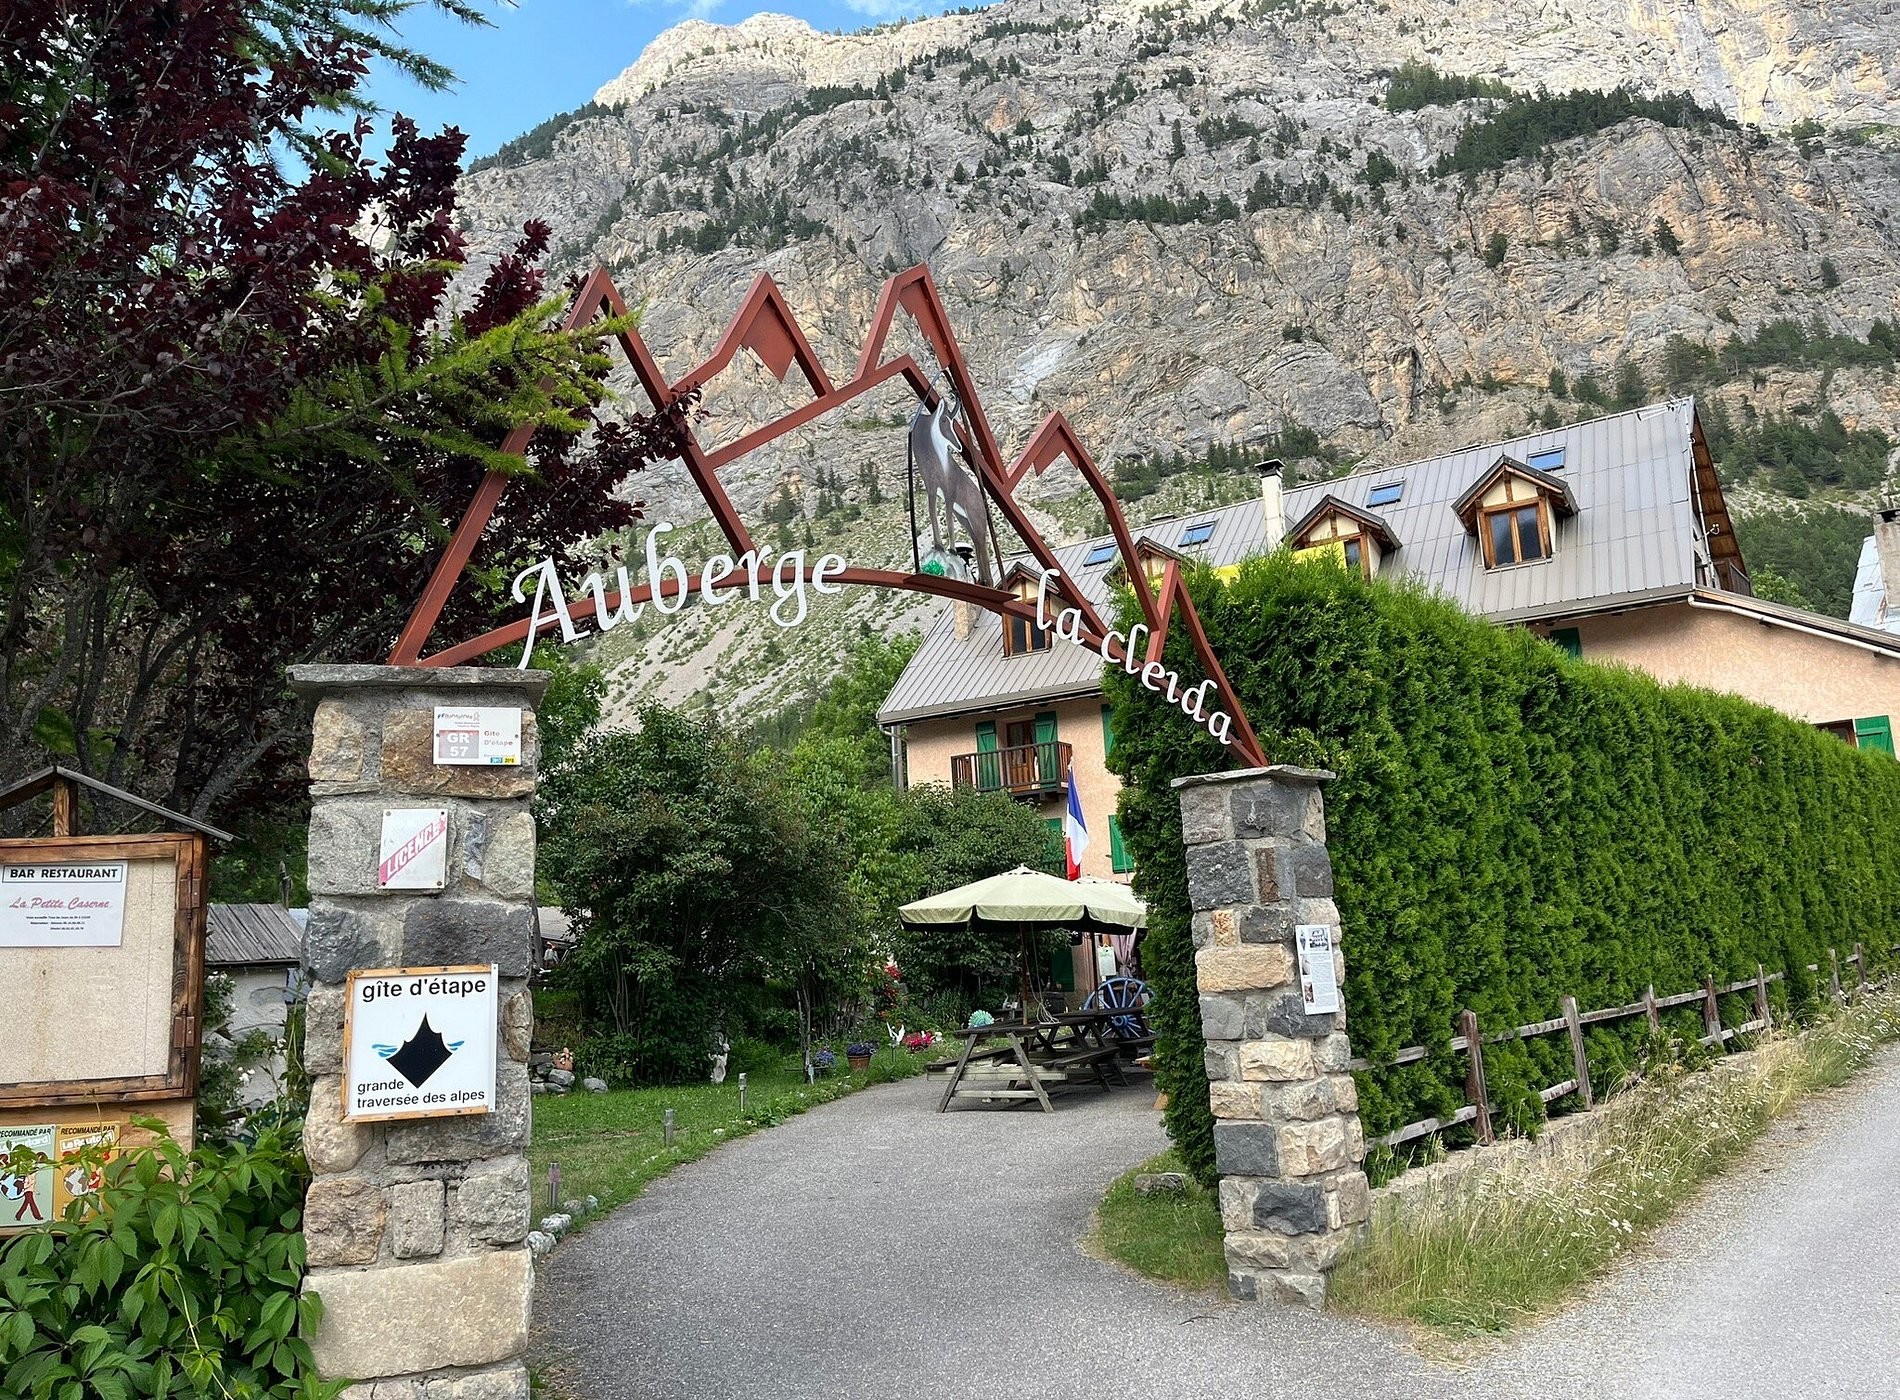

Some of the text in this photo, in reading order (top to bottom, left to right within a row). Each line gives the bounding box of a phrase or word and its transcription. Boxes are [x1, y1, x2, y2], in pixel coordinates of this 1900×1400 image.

[512, 522, 846, 670] Auberge
[1036, 568, 1085, 645] la
[449, 746, 469, 757] 57
[10, 868, 118, 879] BAR RESTAURANT
[9, 896, 111, 910] La Petite Caserne
[362, 977, 486, 1002] gîte d'étape
[357, 1079, 404, 1095] grande
[357, 1090, 485, 1108] traversée des alpes
